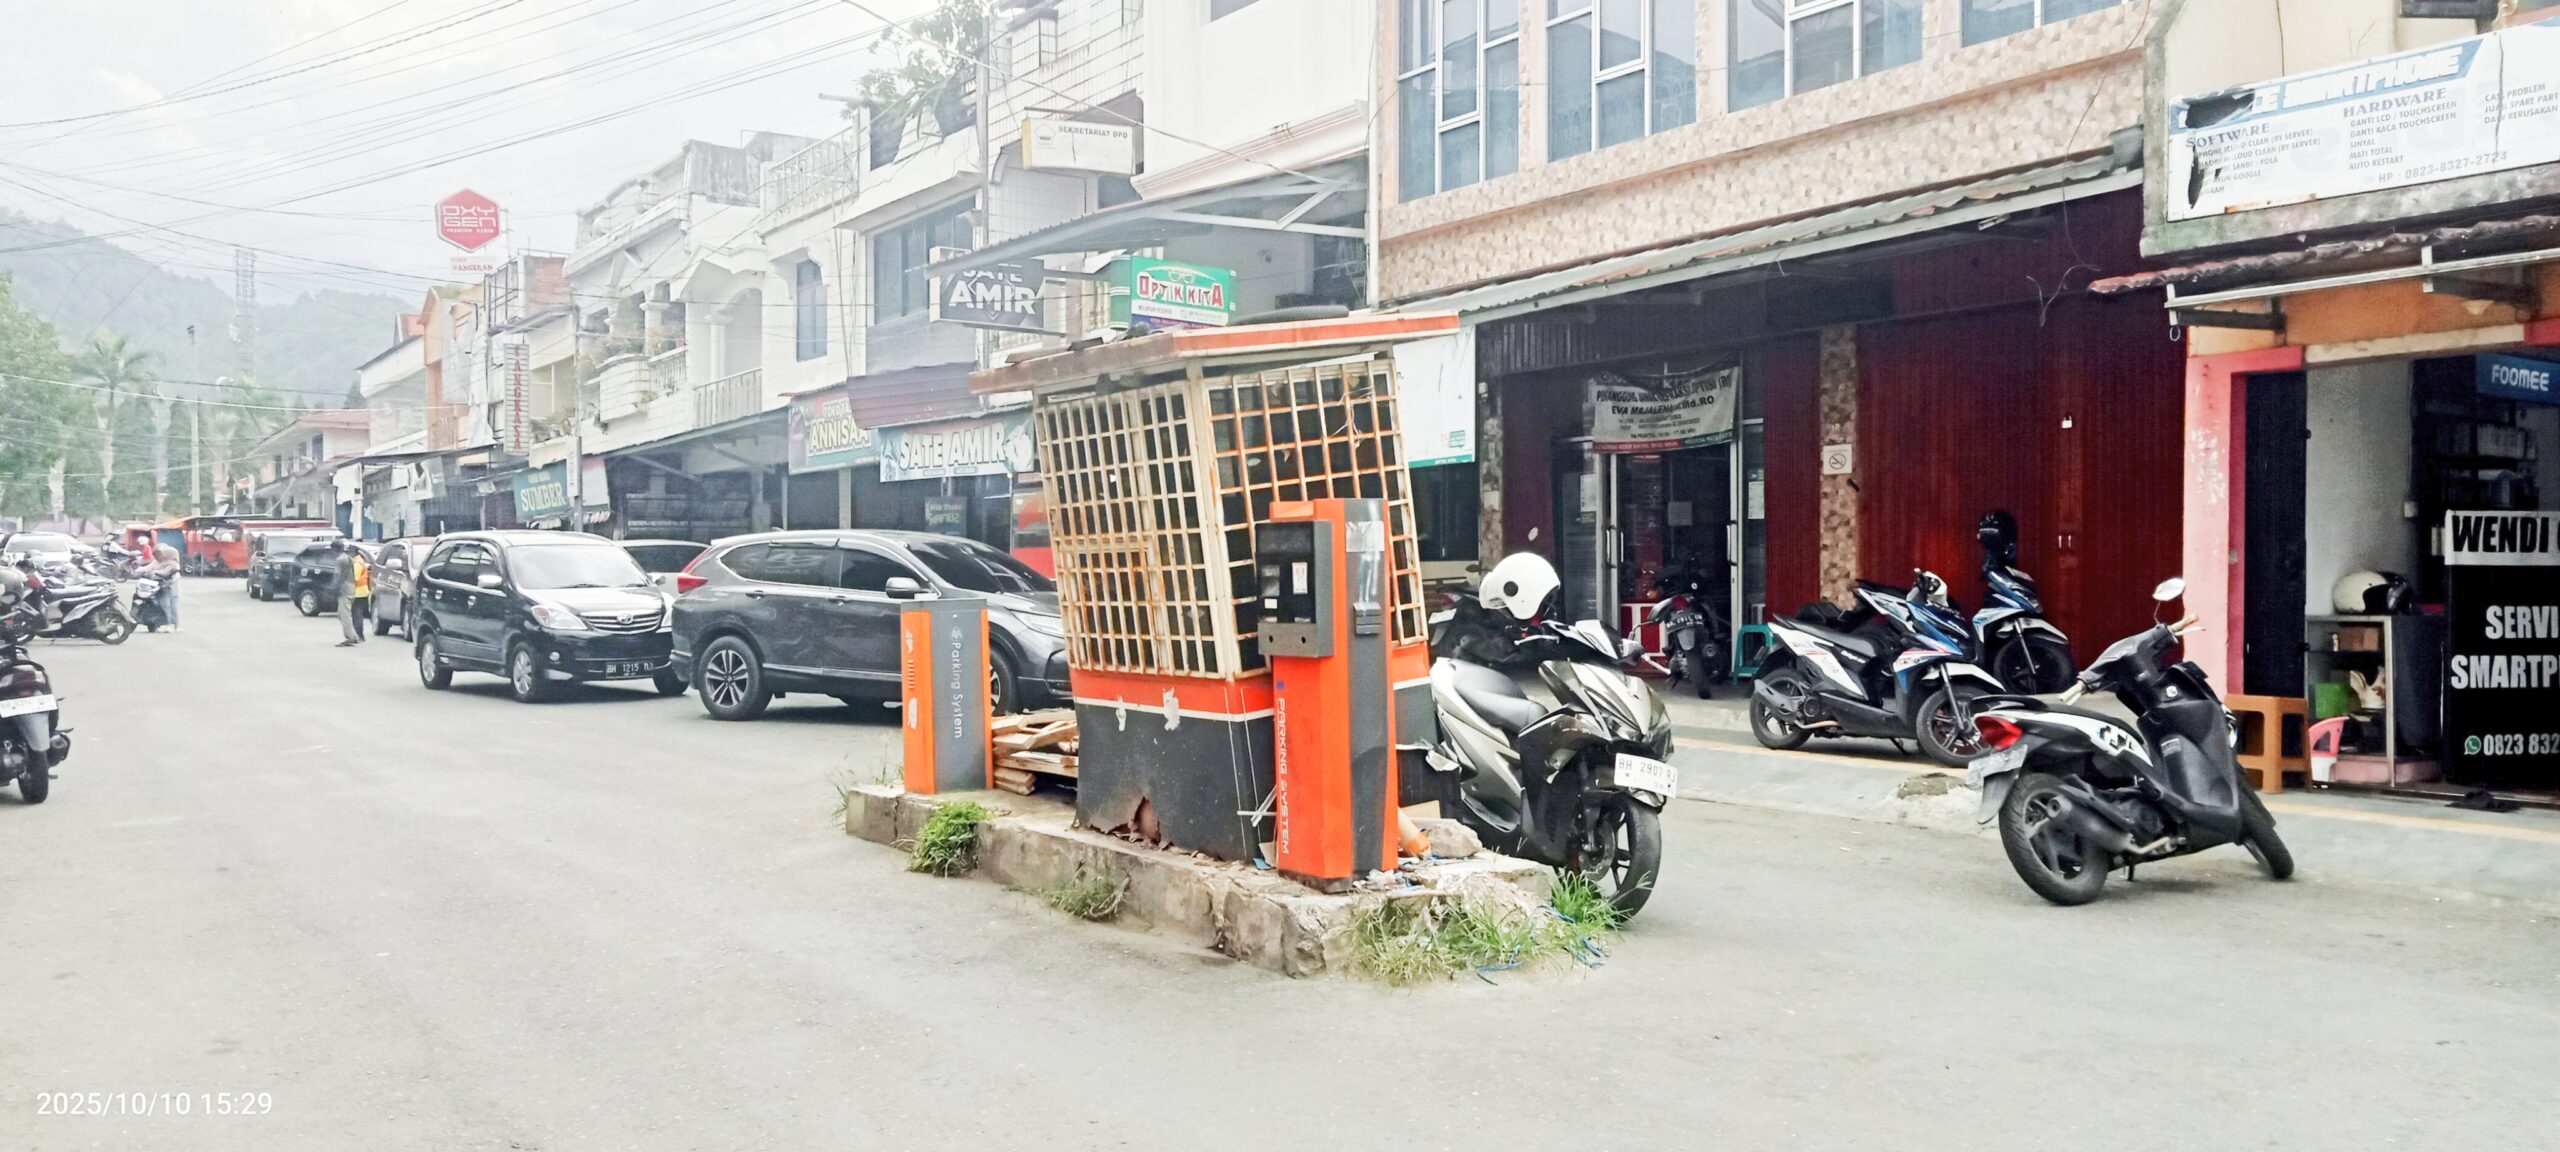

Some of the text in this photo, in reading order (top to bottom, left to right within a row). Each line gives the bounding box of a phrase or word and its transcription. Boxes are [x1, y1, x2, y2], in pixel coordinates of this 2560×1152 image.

[2342, 87, 2447, 118] HARDWARE
[2506, 82, 2546, 99] PROBLEM
[2537, 92, 2559, 104] PART
[2350, 117, 2375, 128] GANTI
[2376, 114, 2391, 124] LCD
[2399, 101, 2457, 119] TOUCHSCREEN
[2350, 112, 2457, 138] GANTI KACA TOUCHSCREEN
[2507, 104, 2559, 121] KERUSAKAN
[1058, 126, 1128, 139] SEKRETARIAT DPD
[2185, 122, 2270, 148] SOFTWARE
[2248, 137, 2269, 148] CLEAN
[2284, 128, 2313, 141] SERVER)
[2350, 138, 2375, 149] SINYAL
[2255, 146, 2276, 157] CLEAN
[2348, 155, 2404, 170] AUTO RESTART
[2349, 146, 2393, 160] MATI TOTAL
[2378, 150, 2507, 183] HP 0823-8327-2724
[442, 205, 495, 217] OXY
[948, 280, 1036, 315] AMIR
[1138, 272, 1224, 308] OPTIK KITA
[2491, 364, 2550, 392] FOOMEE
[1612, 405, 1628, 415] EVA
[900, 422, 1006, 470] SATE AMIR
[520, 481, 566, 512] SUMBER
[2452, 515, 2549, 553] WENDI
[2485, 605, 2559, 639] SERVI
[622, 662, 639, 672] 1215
[2451, 654, 2560, 689] SMARTP
[951, 642, 963, 738] Parking System
[2483, 733, 2560, 756] 0823 832
[1277, 697, 1290, 855] PARKING SYSTEM
[1618, 758, 1633, 770] BH
